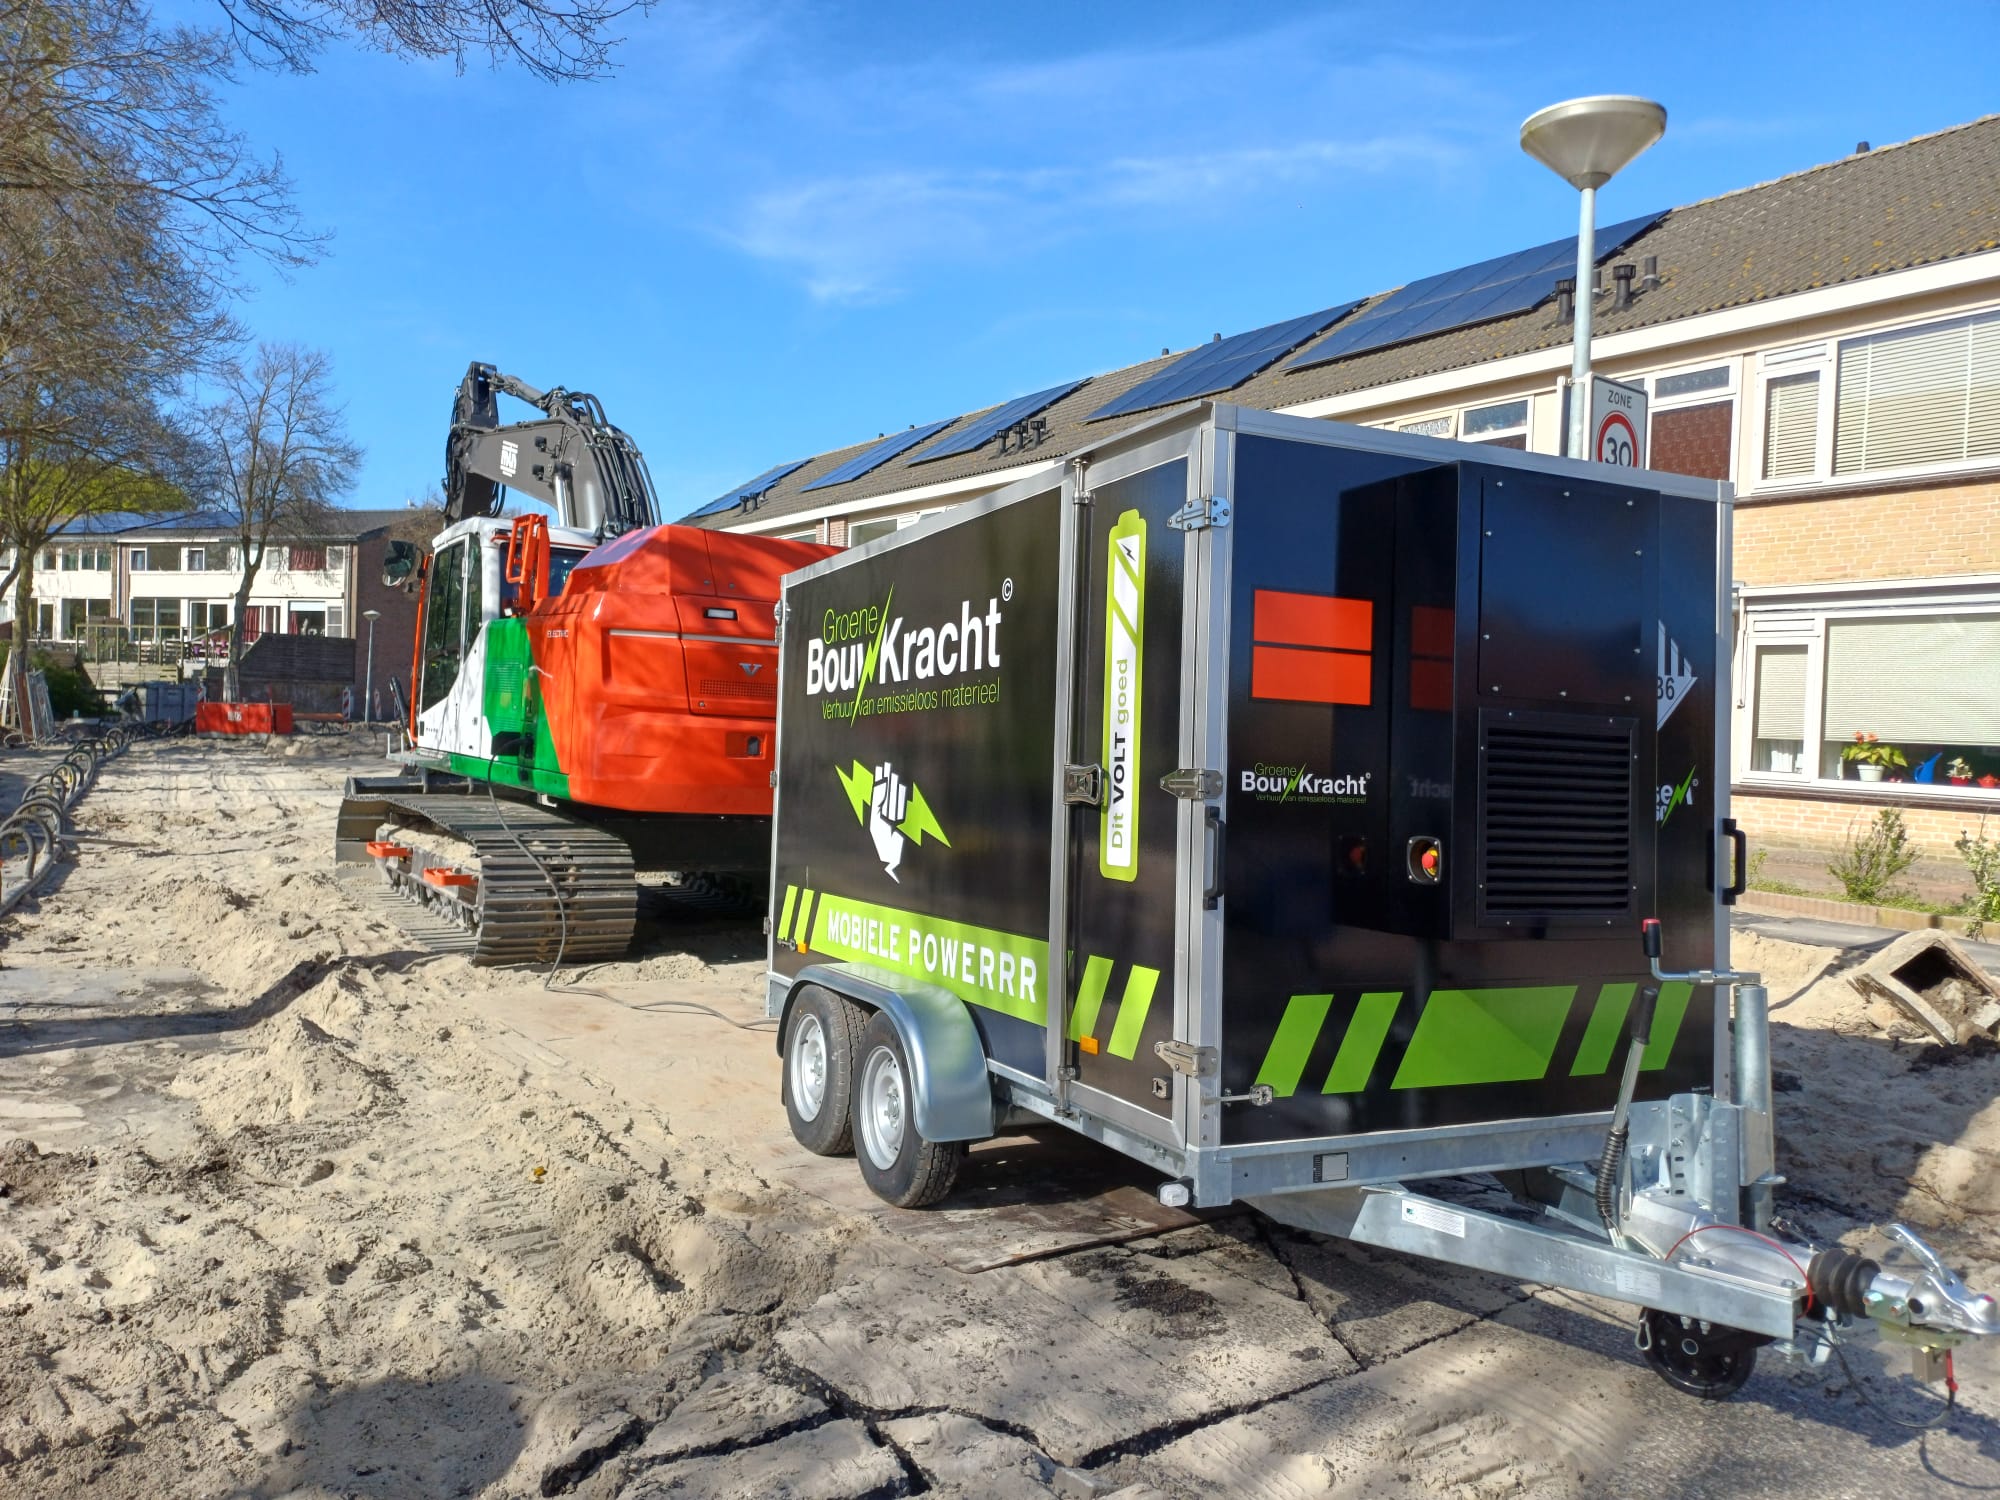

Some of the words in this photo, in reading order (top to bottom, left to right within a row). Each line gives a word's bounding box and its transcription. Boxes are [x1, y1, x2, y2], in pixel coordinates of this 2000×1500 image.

[1607, 389, 1632, 409] ZONE
[1604, 436, 1632, 467] 30
[823, 605, 878, 645] Groene
[821, 698, 854, 720] Verhuur
[858, 697, 875, 716] van
[876, 688, 938, 715] emissieloos
[941, 676, 1000, 708] materieel
[1116, 658, 1129, 725] goed
[1112, 732, 1126, 805] VOLT
[1254, 762, 1297, 777] Groene
[1111, 812, 1124, 849] Dit
[827, 908, 901, 962] MOBIELE
[908, 928, 1037, 1003] POWERRR
